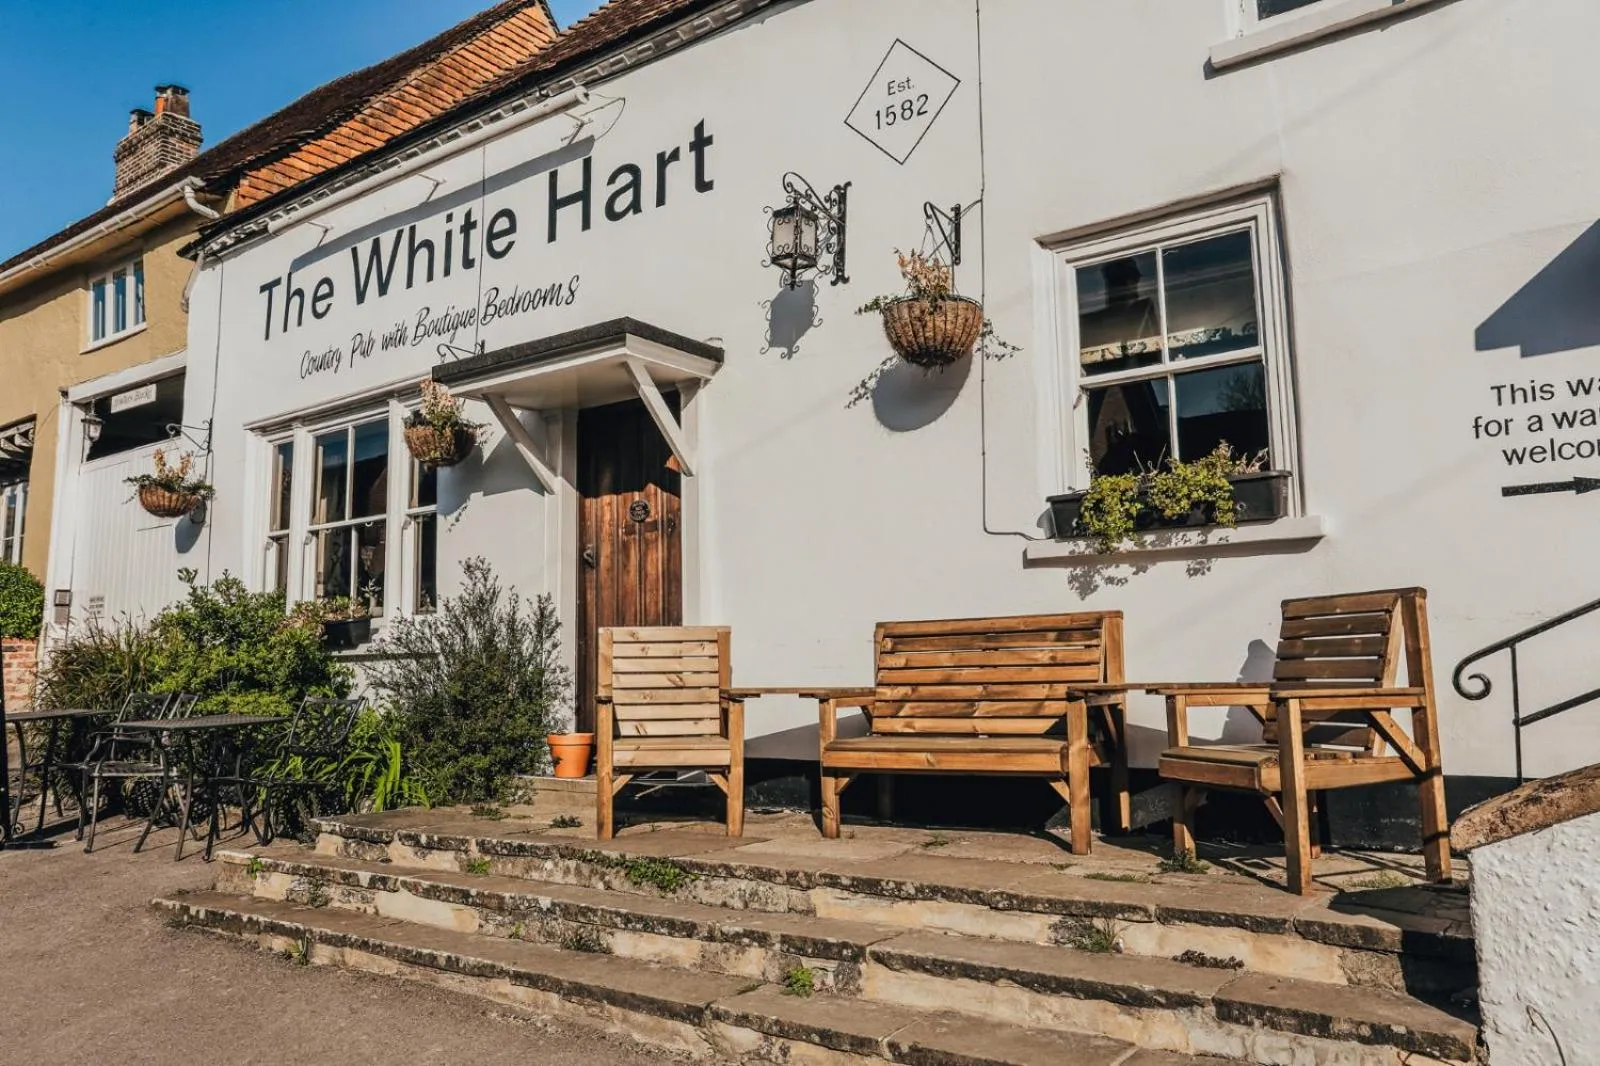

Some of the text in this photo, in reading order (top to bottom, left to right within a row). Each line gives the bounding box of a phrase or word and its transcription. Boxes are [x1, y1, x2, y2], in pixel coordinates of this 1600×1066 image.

[887, 76, 915, 97] Est.
[875, 93, 929, 131] 1582
[258, 117, 715, 341] The White Hart
[300, 274, 580, 380] Country Pub with Boutique Bedrooms
[1490, 377, 1600, 407] This w
[1472, 408, 1600, 440] for a wa
[1501, 437, 1600, 466] welco
